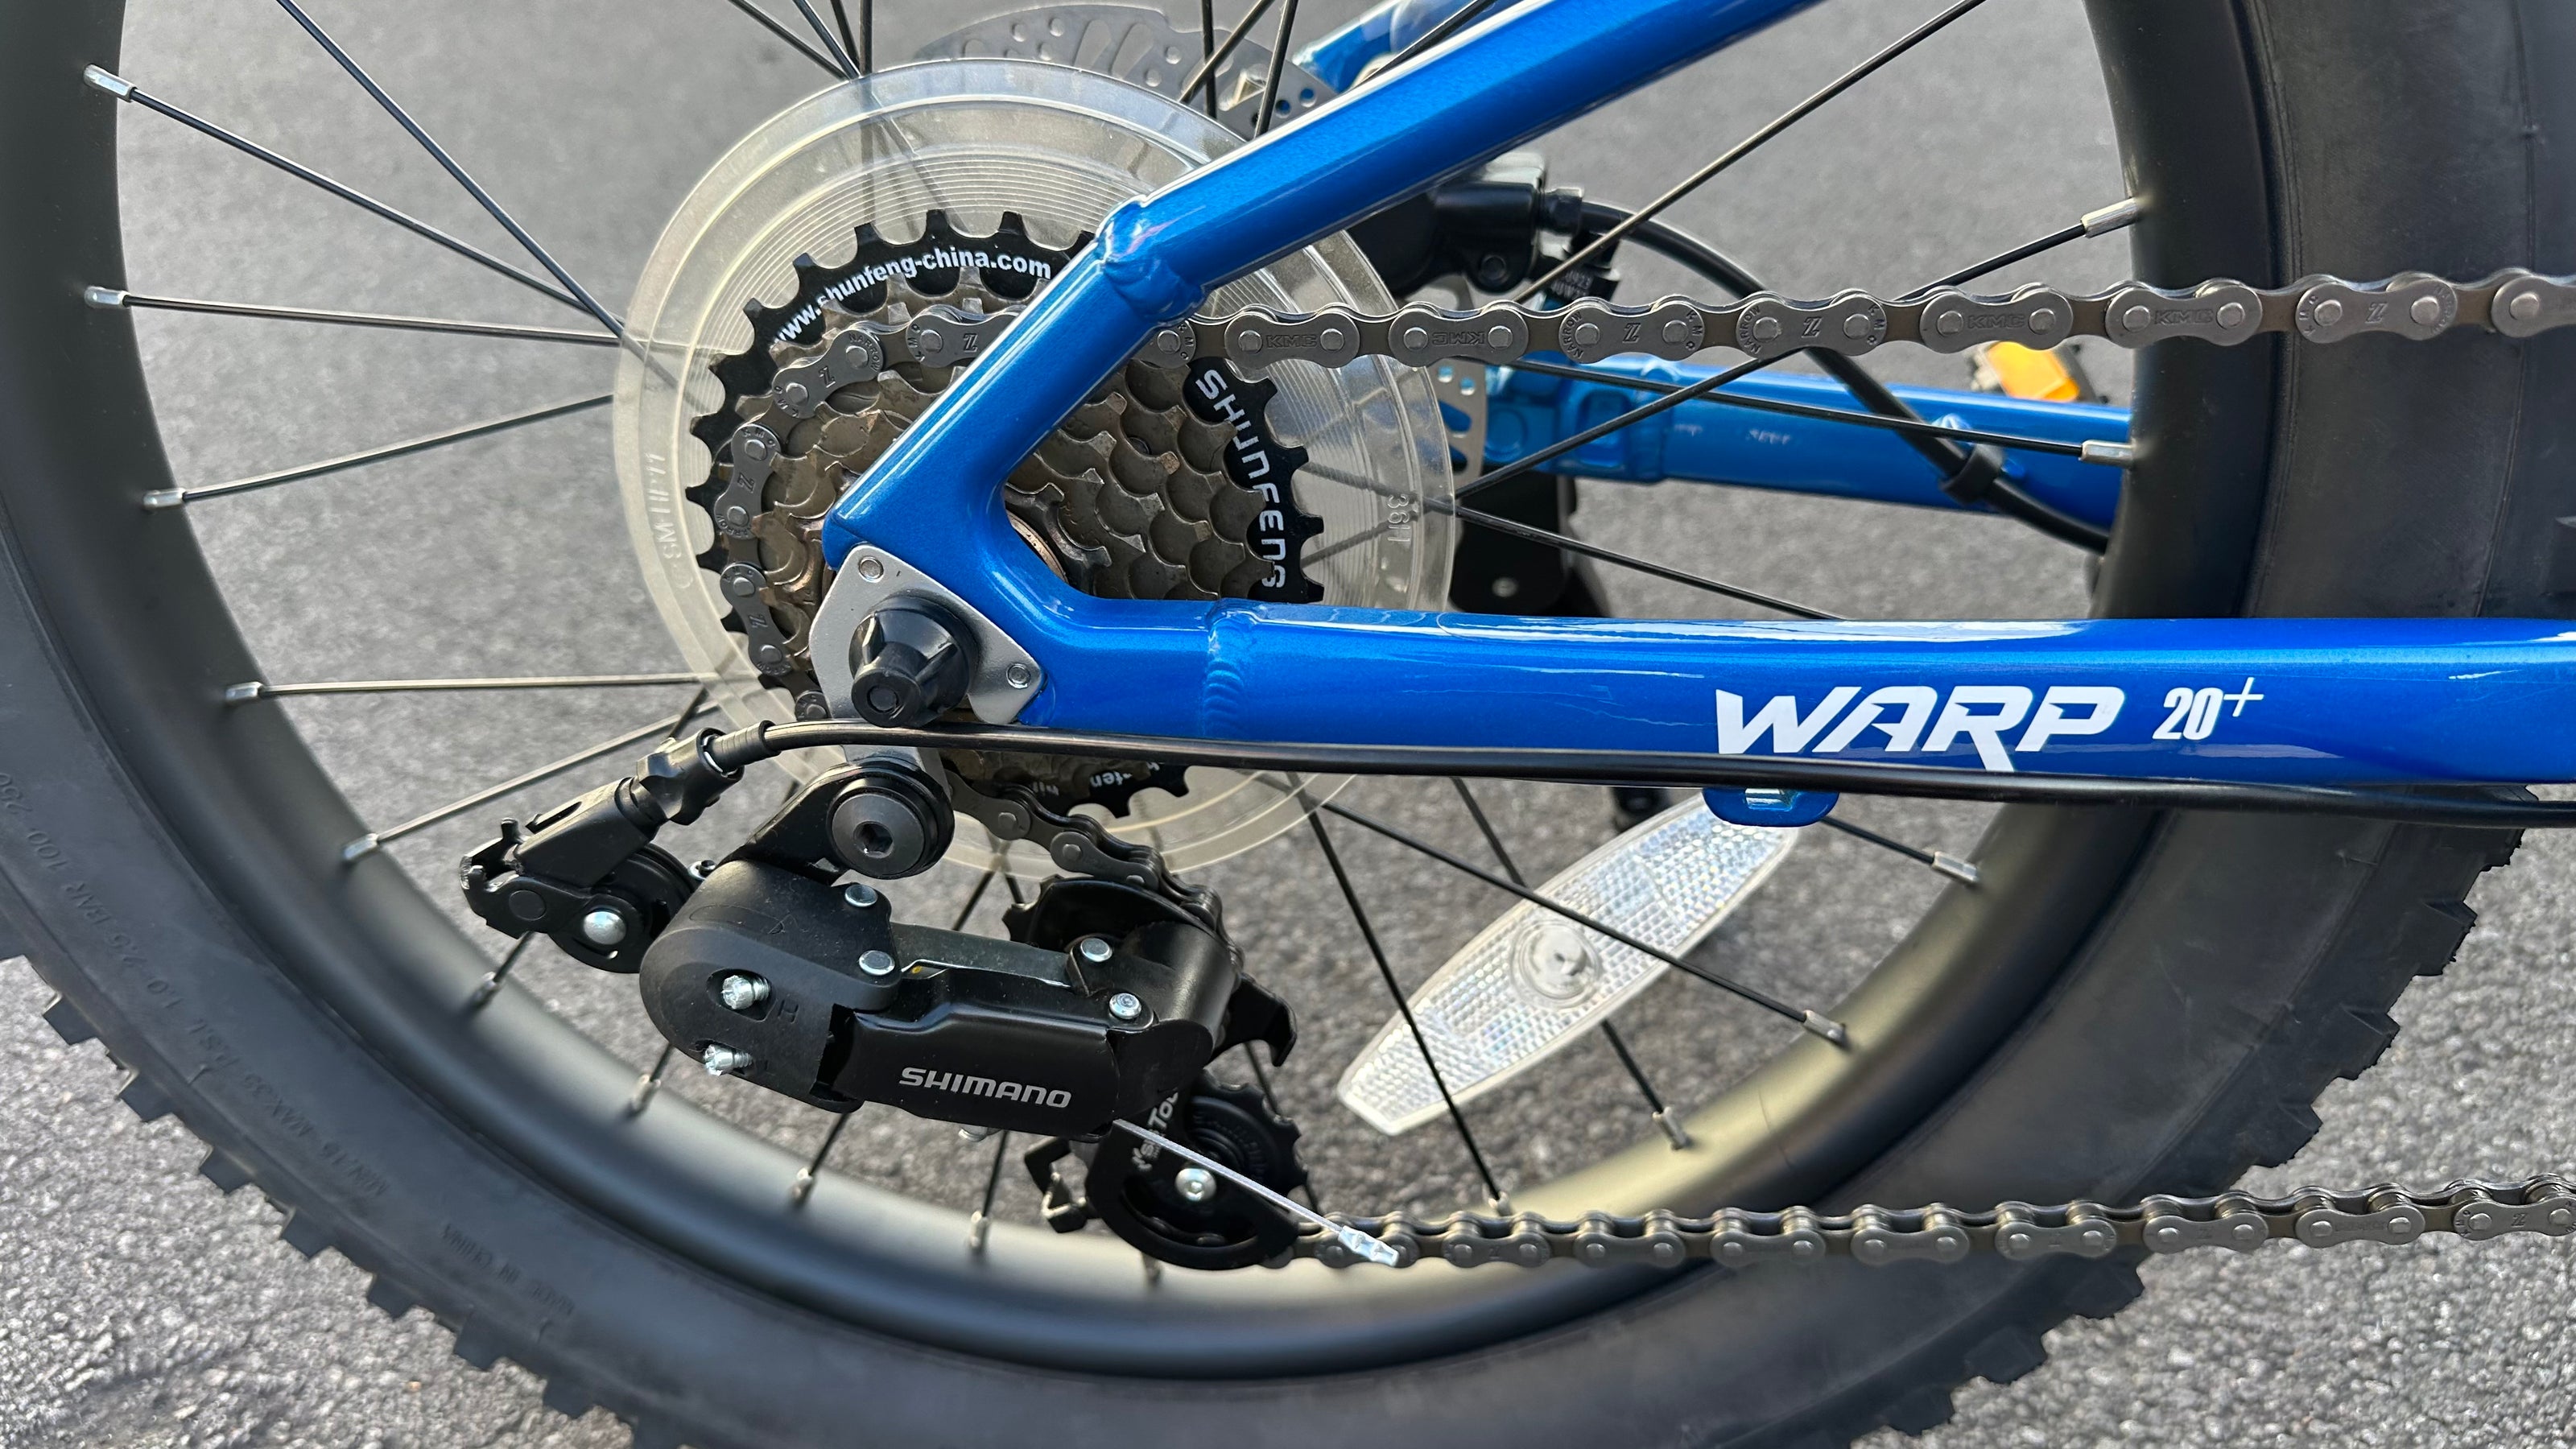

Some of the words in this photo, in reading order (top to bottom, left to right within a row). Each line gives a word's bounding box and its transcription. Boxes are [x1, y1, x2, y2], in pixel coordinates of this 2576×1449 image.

[1563, 311, 1584, 360] NARROW
[1739, 305, 1761, 355] NARROW
[1968, 314, 2026, 329] KMC
[2154, 309, 2214, 325] KMC
[848, 332, 882, 371] NARROW
[1266, 334, 1318, 349] KMC
[1195, 369, 1287, 589] SHUNFENG
[1715, 685, 2125, 773] WARP
[898, 1066, 1072, 1109] SHIMANO
